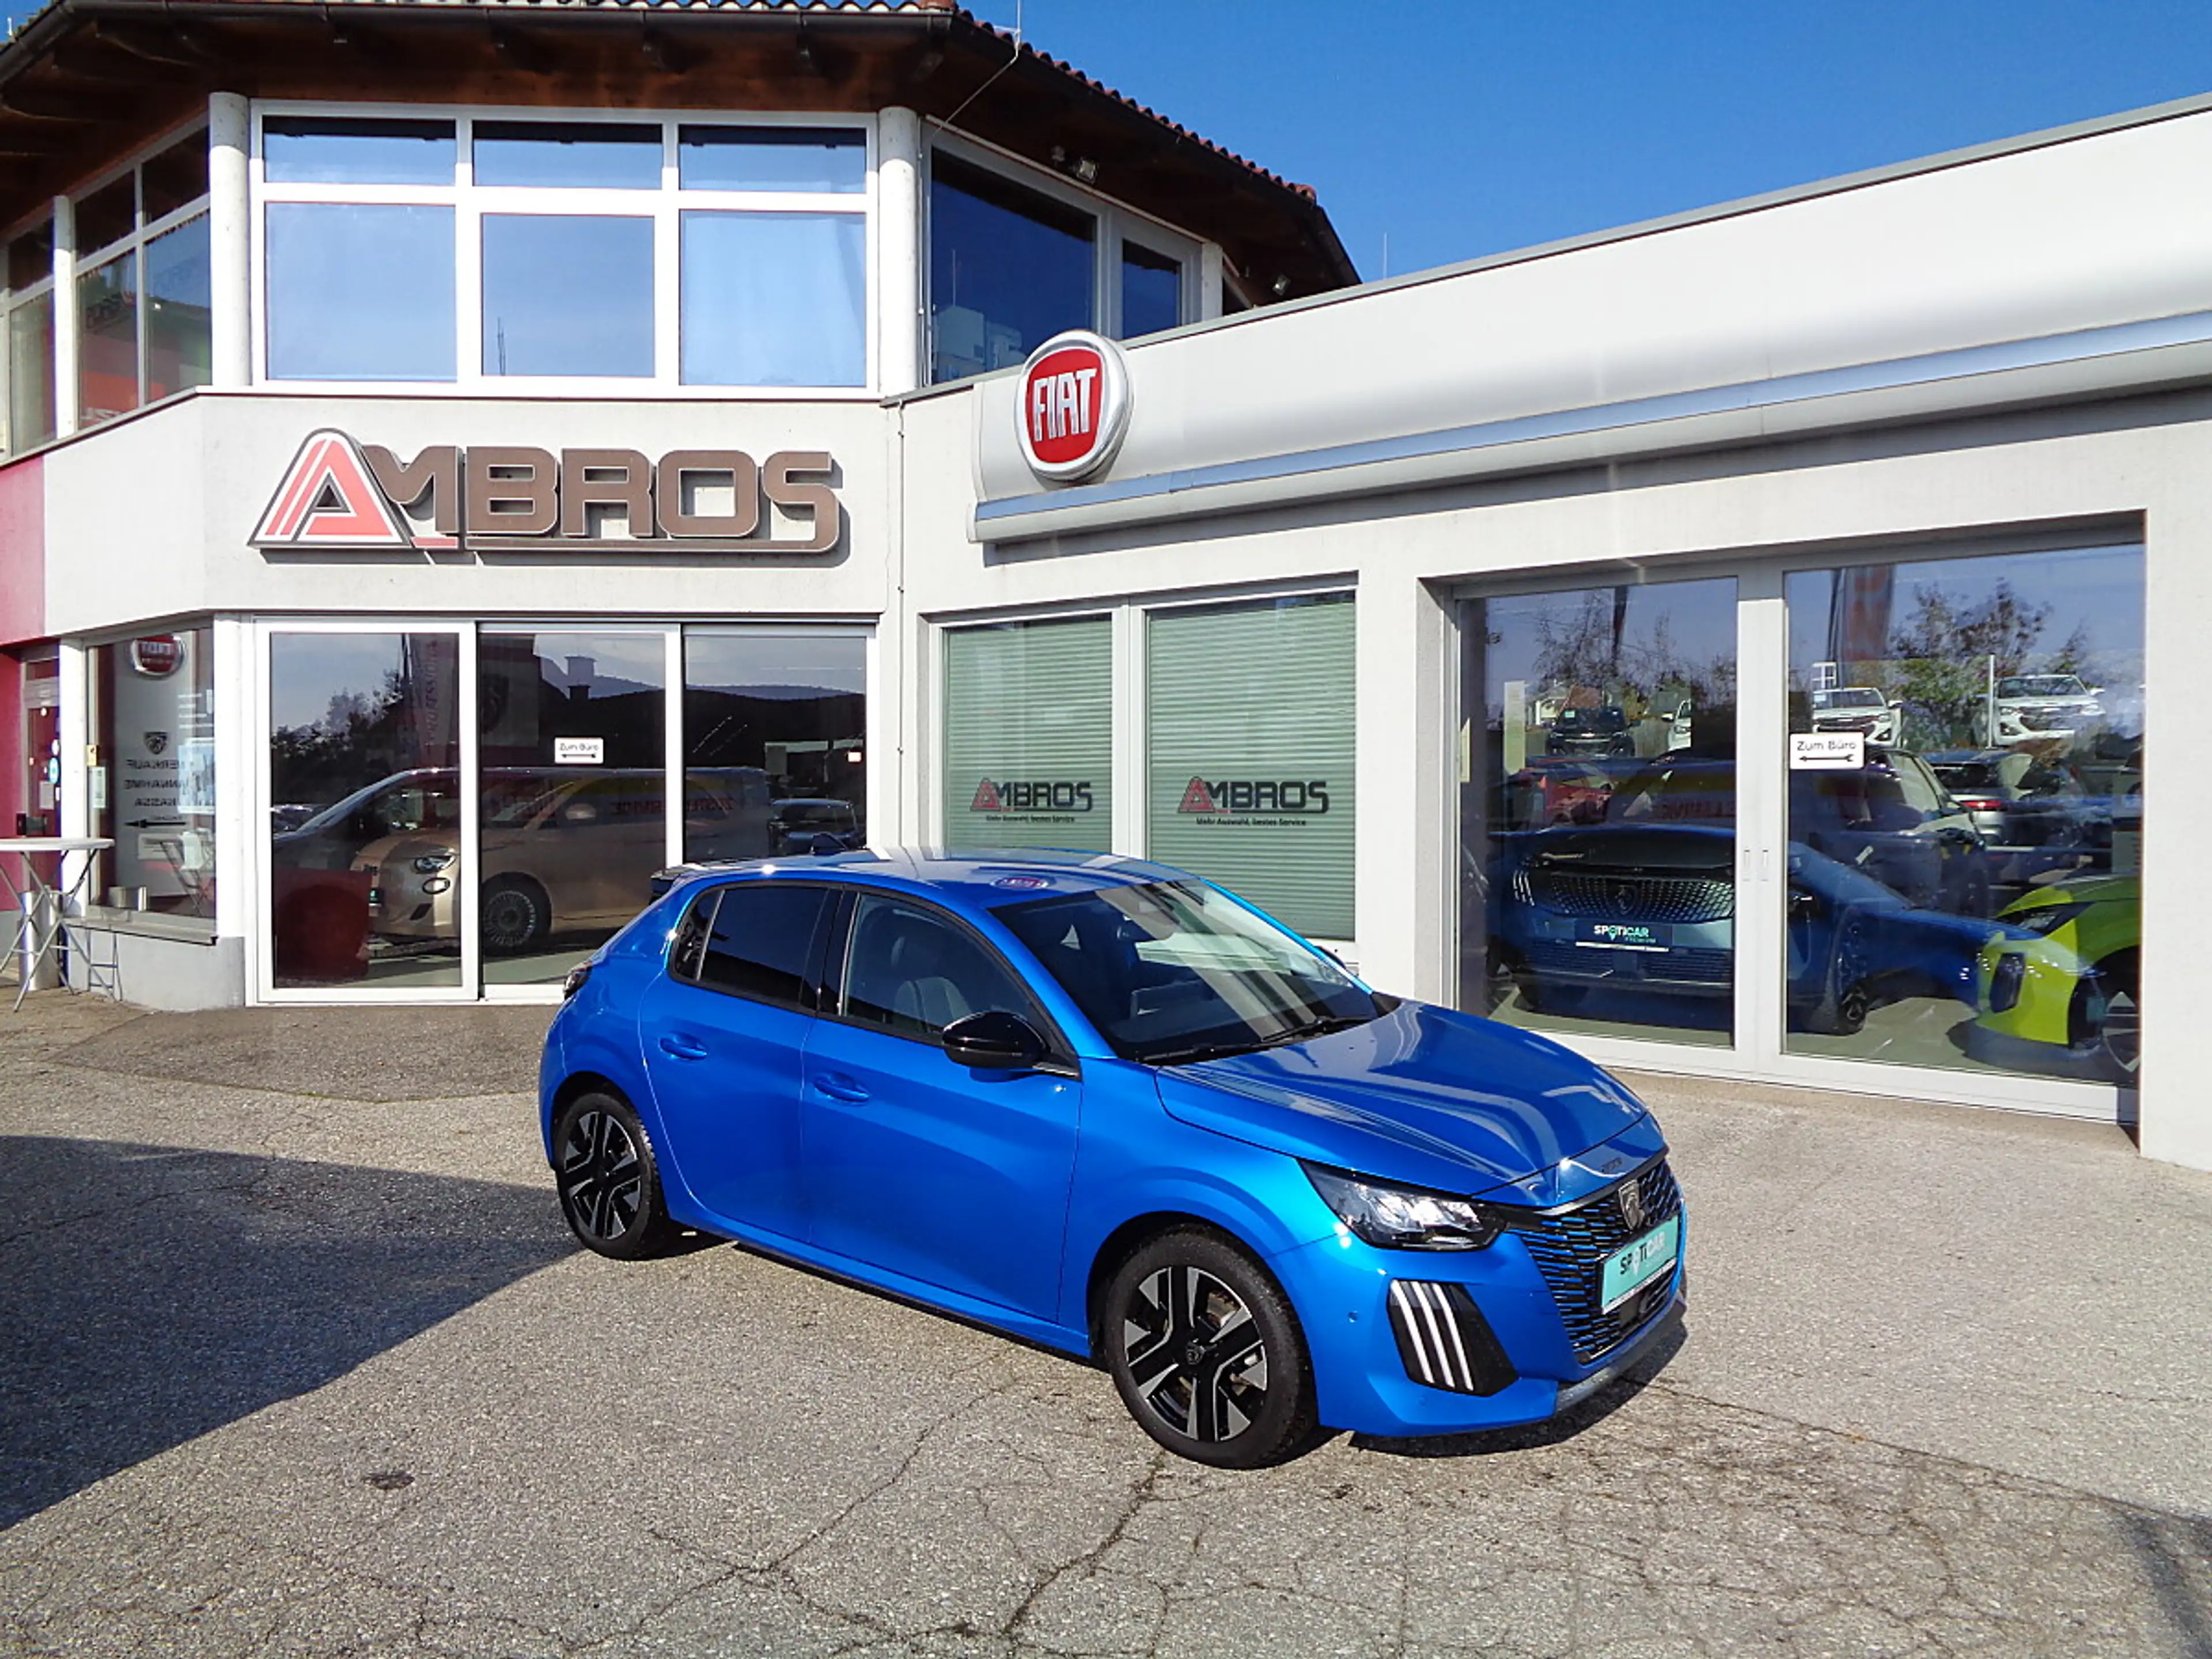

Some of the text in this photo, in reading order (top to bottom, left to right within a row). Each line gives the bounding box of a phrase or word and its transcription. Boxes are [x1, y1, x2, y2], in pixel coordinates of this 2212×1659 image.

[1033, 368, 1097, 442] FIAT
[248, 428, 840, 552] AMBROS
[1797, 738, 1857, 751] Zum Büro
[970, 778, 1092, 812] AMBROS
[1177, 777, 1330, 813] AMBROS
[1593, 925, 1649, 940] SPOTICAR
